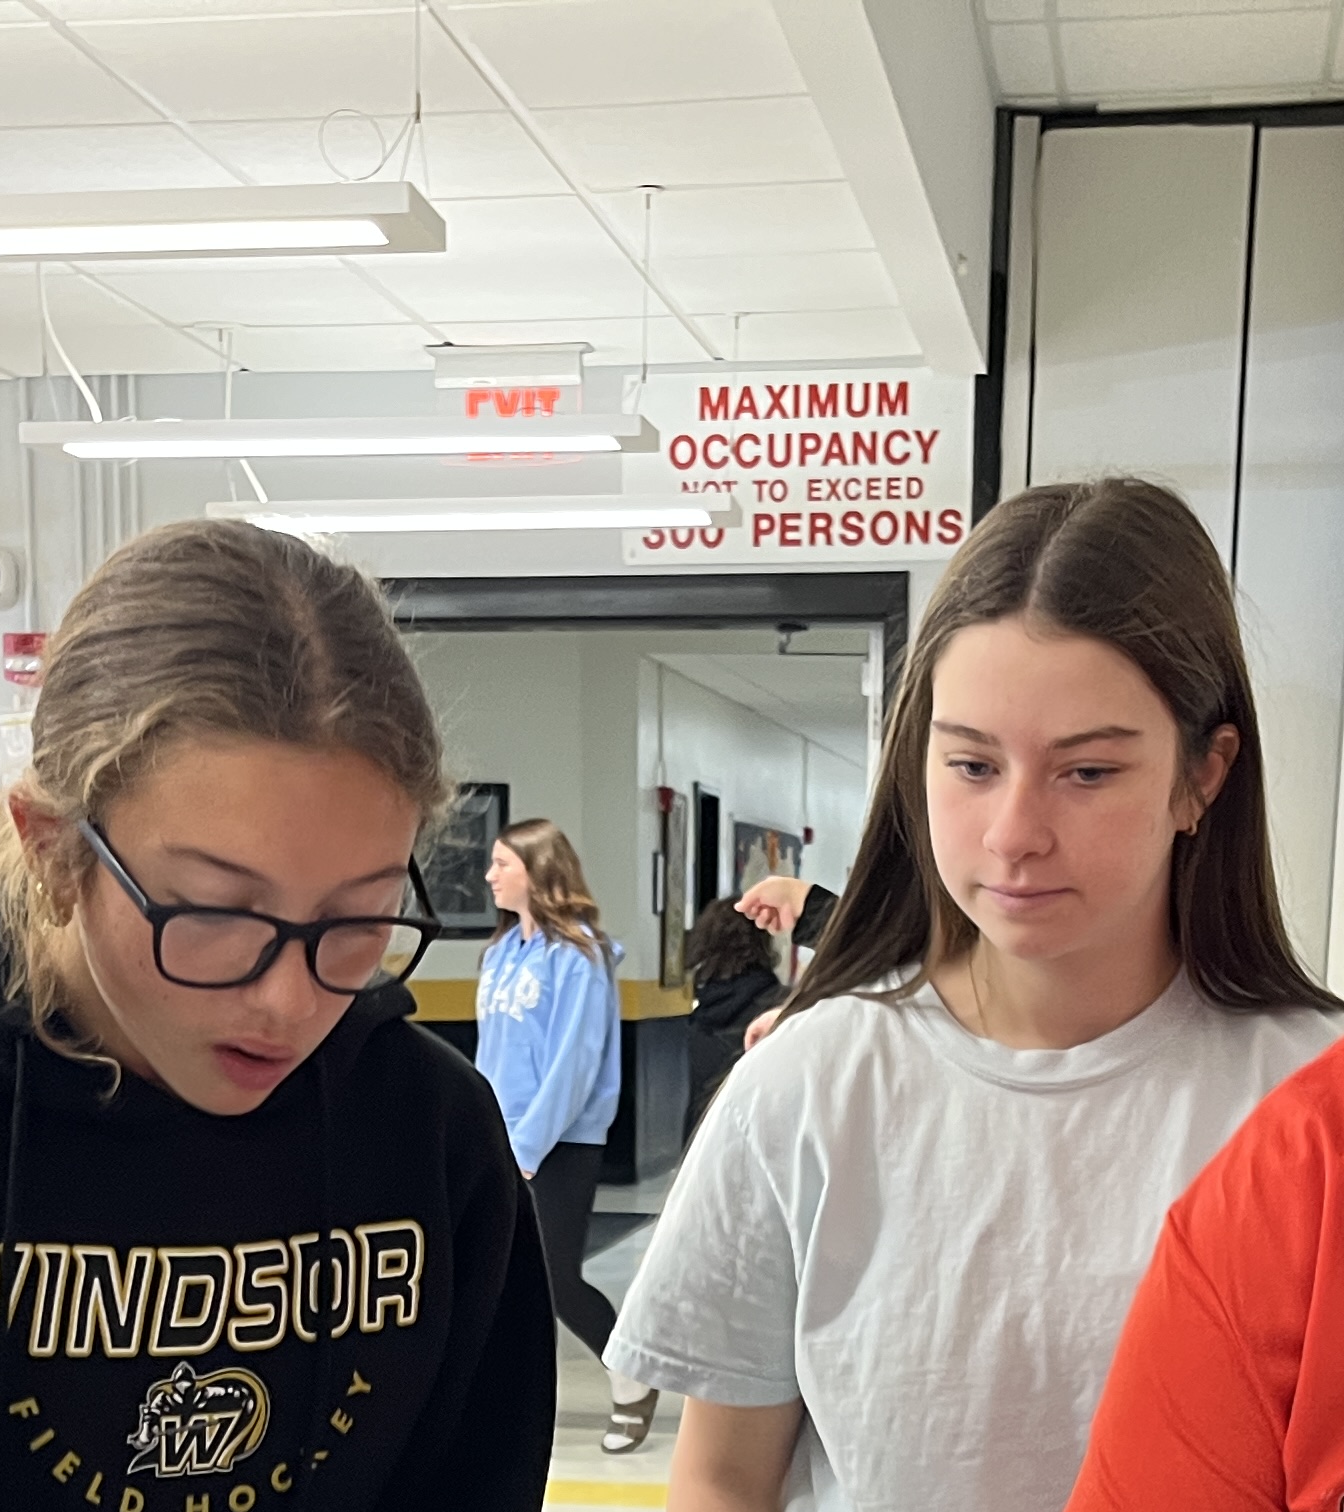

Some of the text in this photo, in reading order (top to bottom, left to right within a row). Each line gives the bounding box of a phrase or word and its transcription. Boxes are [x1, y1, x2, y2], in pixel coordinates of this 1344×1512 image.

[697, 380, 910, 421] MAXIMUM
[668, 428, 940, 471] OCCUPANCY
[752, 479, 789, 503] TO
[806, 476, 924, 501] EXCEED
[752, 508, 964, 549] PERSONS
